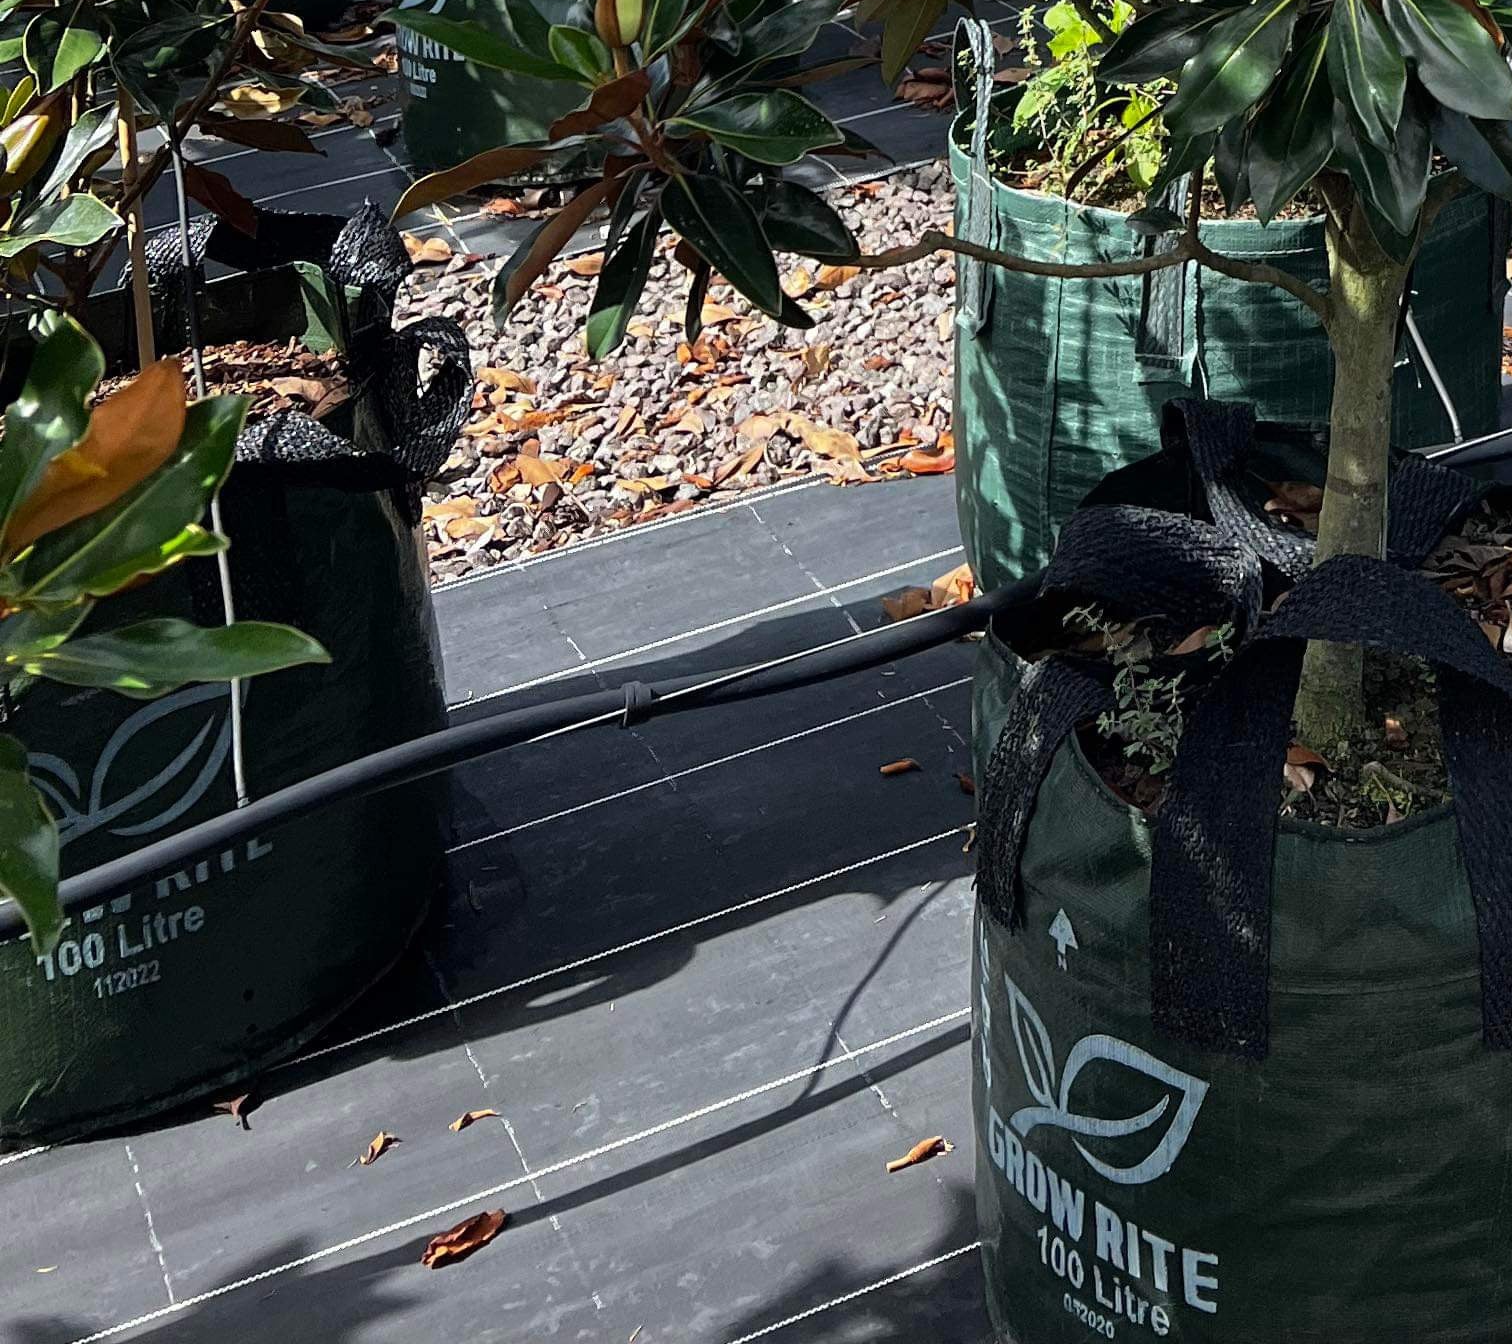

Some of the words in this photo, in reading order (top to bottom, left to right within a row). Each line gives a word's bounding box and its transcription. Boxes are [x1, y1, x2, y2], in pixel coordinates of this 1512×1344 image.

[37, 932, 105, 981] 100
[117, 906, 205, 958] Litre
[989, 1105, 1085, 1242] GROW
[1095, 1201, 1219, 1313] RITE
[1037, 1226, 1084, 1289] 100
[1094, 1265, 1170, 1336] Litre
